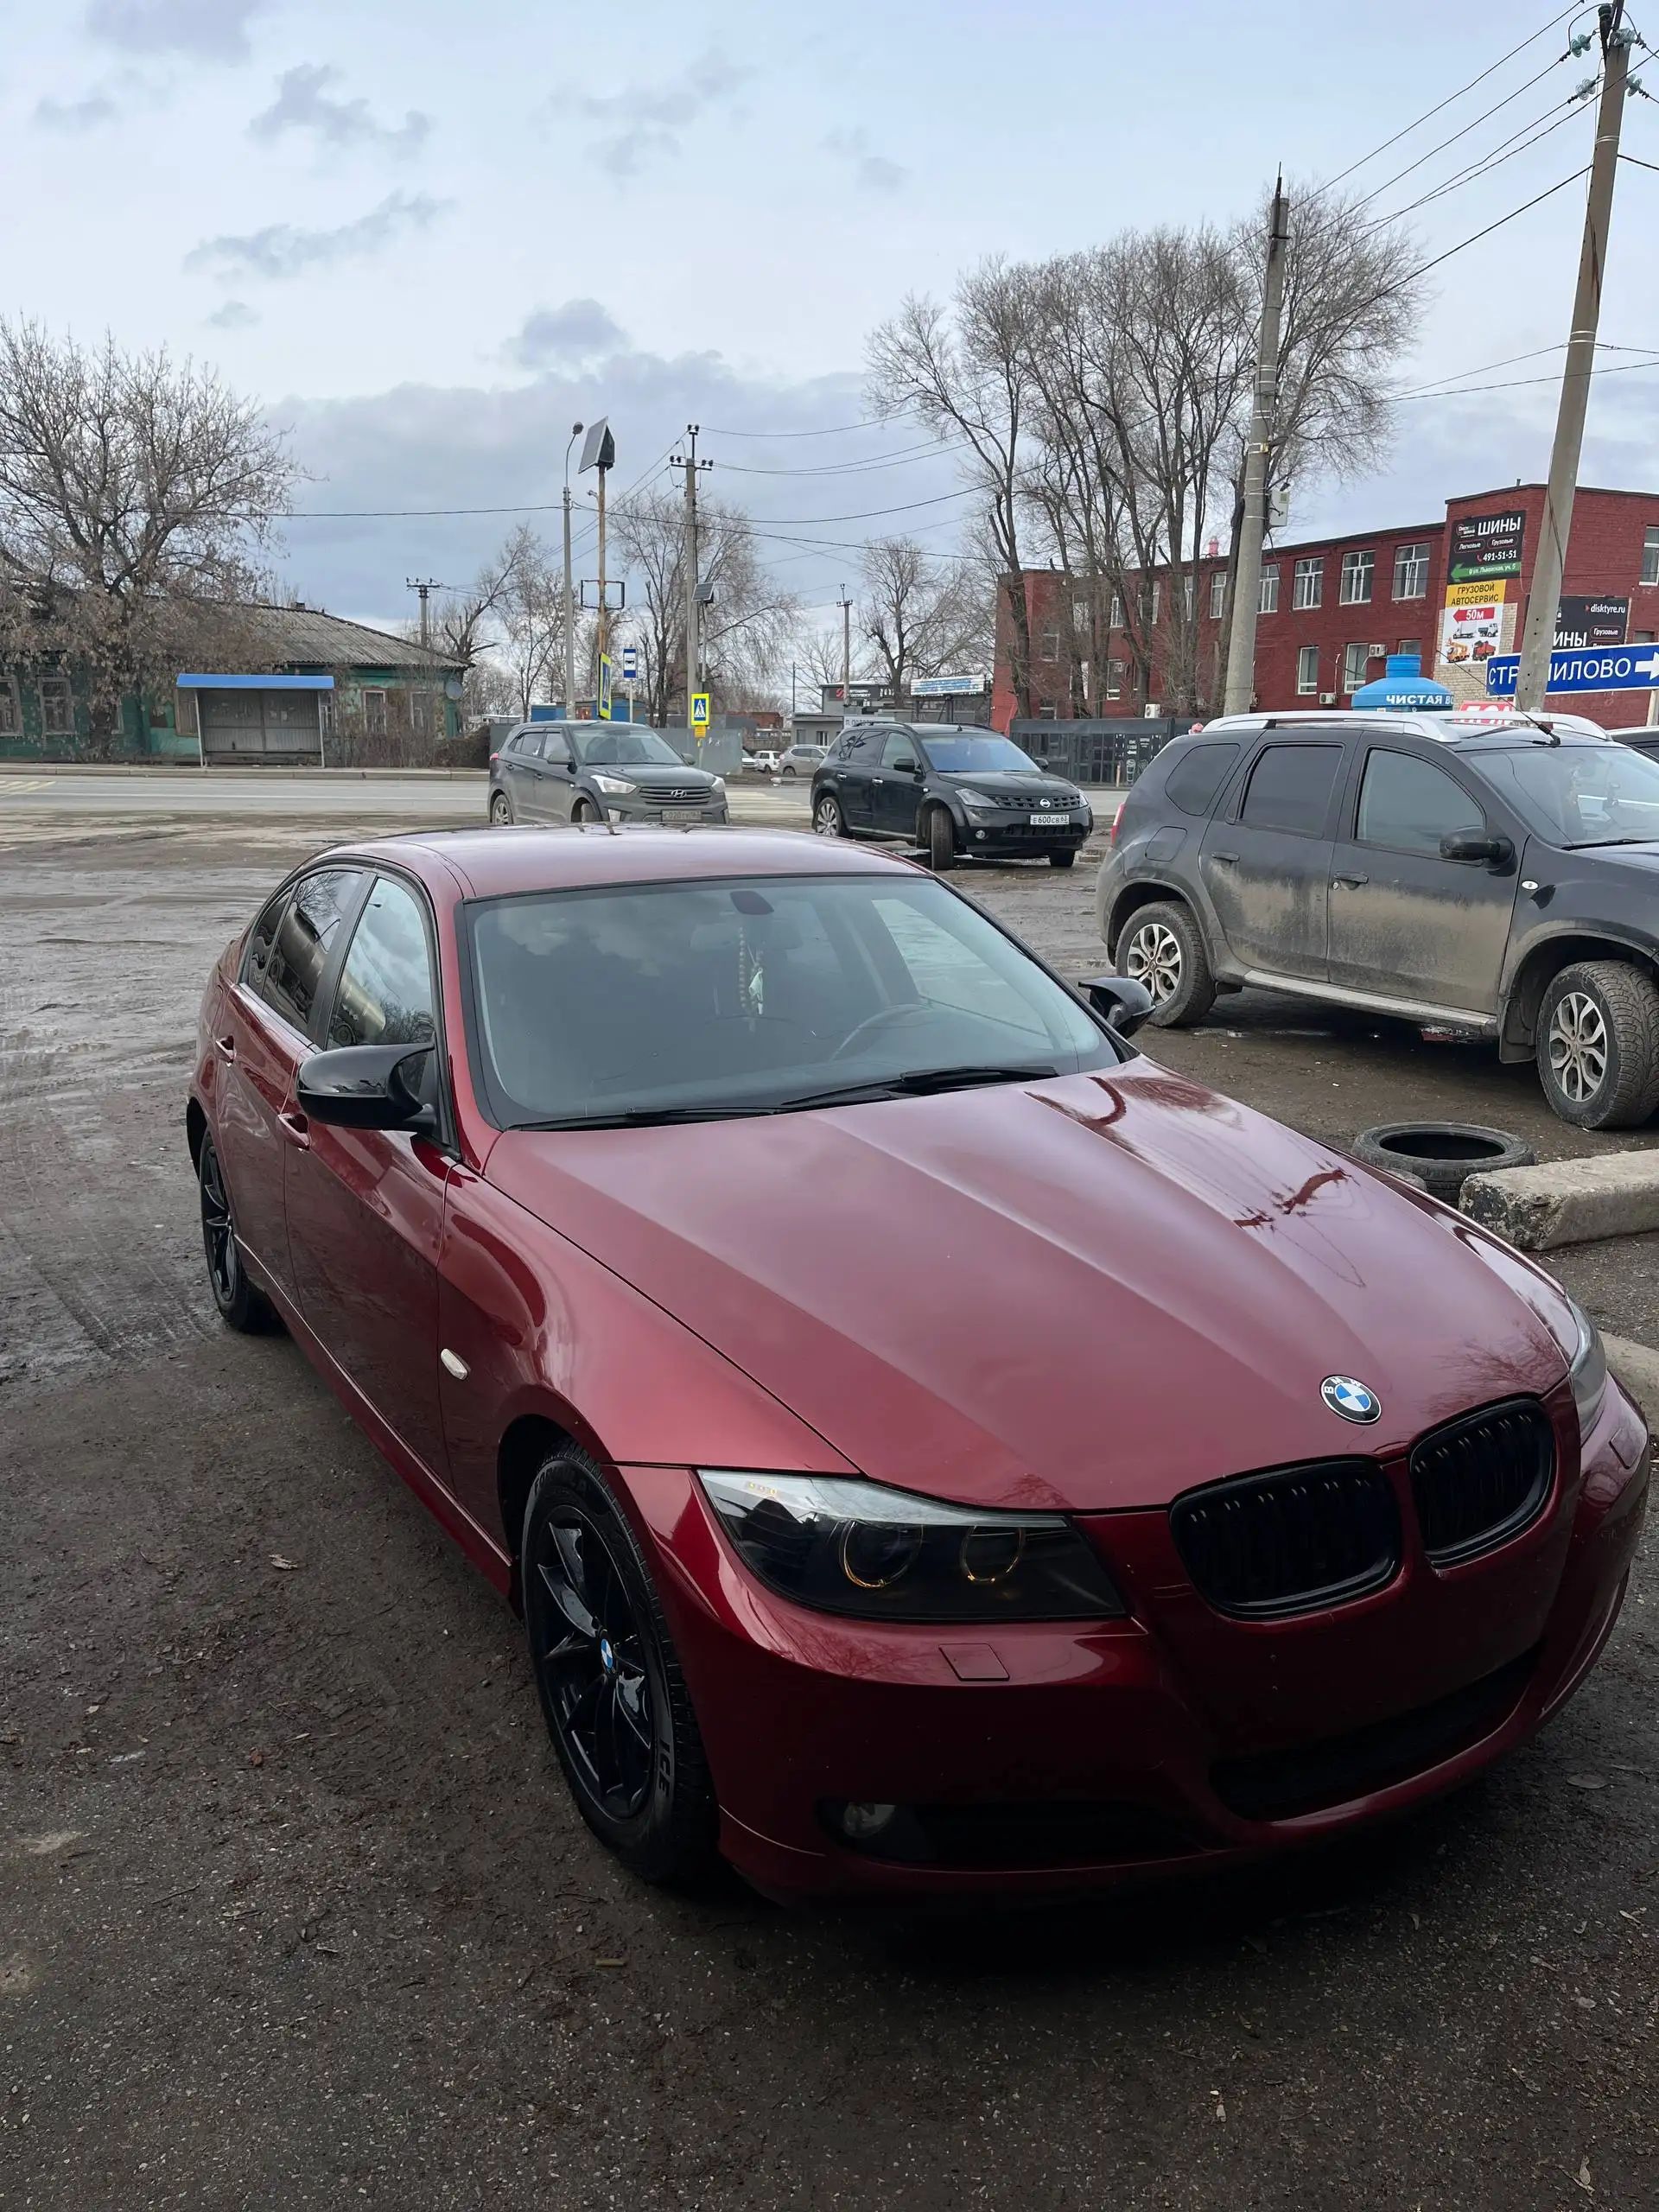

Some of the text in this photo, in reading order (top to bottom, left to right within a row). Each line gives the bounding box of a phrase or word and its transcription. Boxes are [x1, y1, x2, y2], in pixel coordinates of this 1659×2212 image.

[1478, 516, 1521, 536] ШИНЫ
[1483, 550, 1516, 561] 491-51-51
[1457, 582, 1495, 594] ГРУЗОВОЙ
[1451, 594, 1499, 606] АВТОСЕРВИС
[1590, 603, 1626, 614] disktyre.ru
[1593, 627, 1618, 636] Грузовые
[1553, 631, 1588, 647] ИНЫ
[1488, 657, 1631, 686] СТРИЛОВО
[1386, 695, 1442, 705] ЧИСТАЯ
